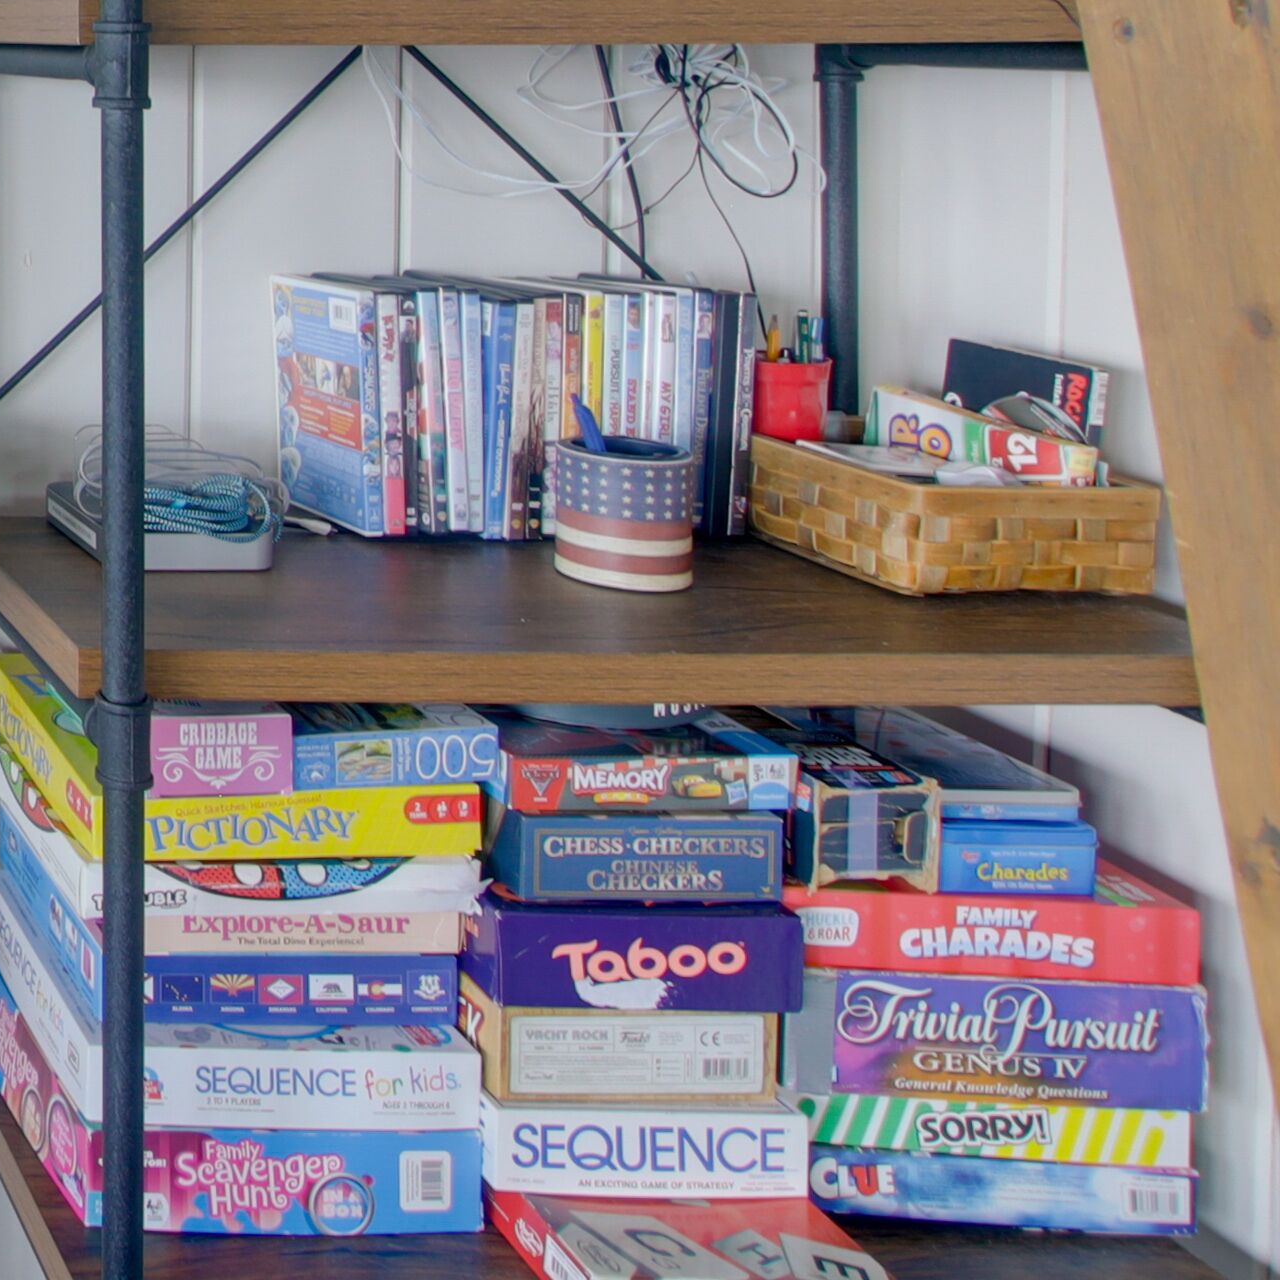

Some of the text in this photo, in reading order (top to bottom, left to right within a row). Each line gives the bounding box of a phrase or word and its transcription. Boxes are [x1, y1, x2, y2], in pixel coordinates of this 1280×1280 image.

[610, 348, 621, 394] PURSUIT
[659, 381, 673, 440] MY GIRL
[1006, 431, 1038, 473] 12
[180, 722, 258, 746] CRIBBAGE
[195, 746, 242, 770] GAME
[572, 763, 669, 791] MEMORY
[146, 805, 357, 852] PICTIONARY
[543, 835, 766, 859] CHESS CHECKERS
[611, 859, 698, 874] CHINESE
[976, 862, 1069, 882] Charades
[586, 870, 724, 892] CHECKERS
[182, 914, 410, 941] Explore-A-Saur
[955, 905, 1037, 929] FAMILY
[237, 936, 365, 947] The Total Dino Experience!
[817, 927, 851, 941] ROAR
[898, 926, 1095, 968] CHARADES
[551, 936, 747, 983] Taboo
[525, 1029, 609, 1041] YACHT ROCK
[837, 979, 1163, 1064] Trivial Pursuit
[912, 1051, 1088, 1079] GENUS IV
[195, 1065, 357, 1098] SEQUENCE
[363, 1069, 404, 1101] for
[894, 1075, 1109, 1100] General Knowledge Questions
[920, 1111, 1047, 1143] SORRY!
[203, 1139, 262, 1162] Family
[511, 1122, 786, 1174] SEQUENCE
[175, 1151, 343, 1194] Scavenger
[578, 1179, 592, 1188] AN
[594, 1179, 639, 1190] EXCITING
[641, 1180, 668, 1190] GAME
[671, 1181, 685, 1190] OF
[686, 1181, 735, 1191] STRATEGY
[808, 1155, 897, 1199] CLUE
[210, 1180, 289, 1216] Hunt
